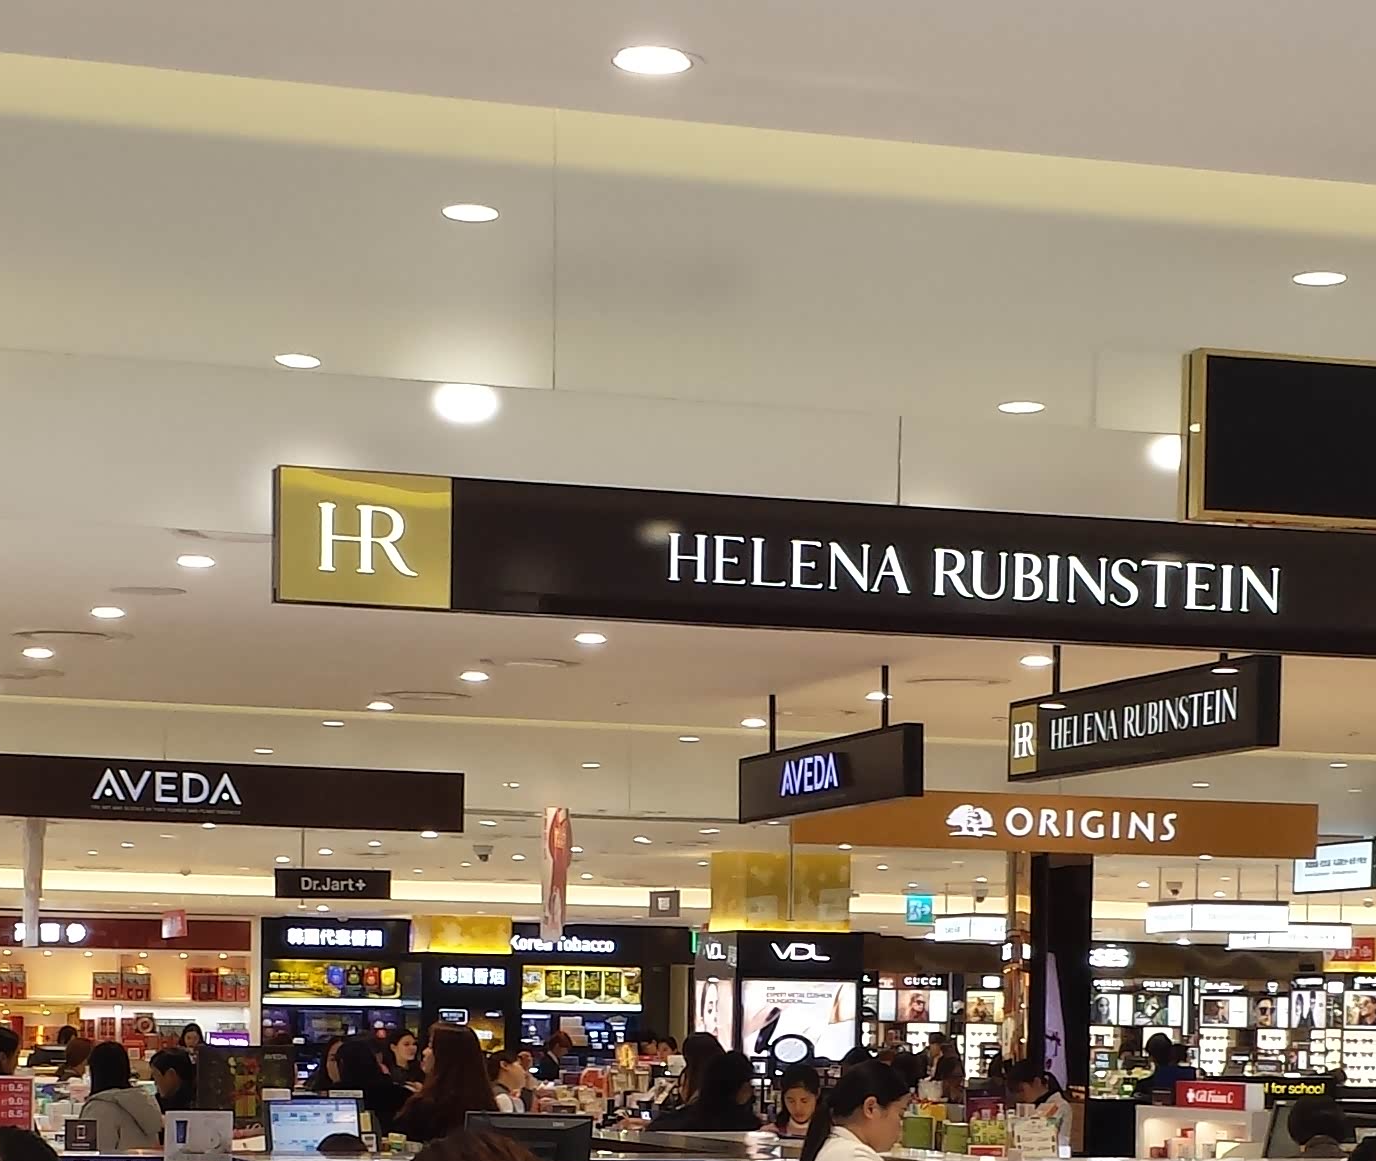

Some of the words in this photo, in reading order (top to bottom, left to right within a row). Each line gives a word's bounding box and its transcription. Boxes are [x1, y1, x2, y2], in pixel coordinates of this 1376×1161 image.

[316, 501, 418, 578] HR
[667, 531, 912, 595] HELENA
[932, 548, 1281, 614] RUBINSTEIN
[1049, 707, 1119, 751] HELENA
[1123, 687, 1239, 740] RUBINSTEIN
[91, 767, 243, 806] AVEDA
[779, 751, 840, 797] AVEDA
[1005, 807, 1179, 842] ORIGINS
[300, 876, 367, 892] Dr.Jart+
[770, 942, 832, 962] VDL
[903, 976, 942, 987] GUCCI
[1271, 1082, 1286, 1094] for
[1288, 1083, 1325, 1094] school
